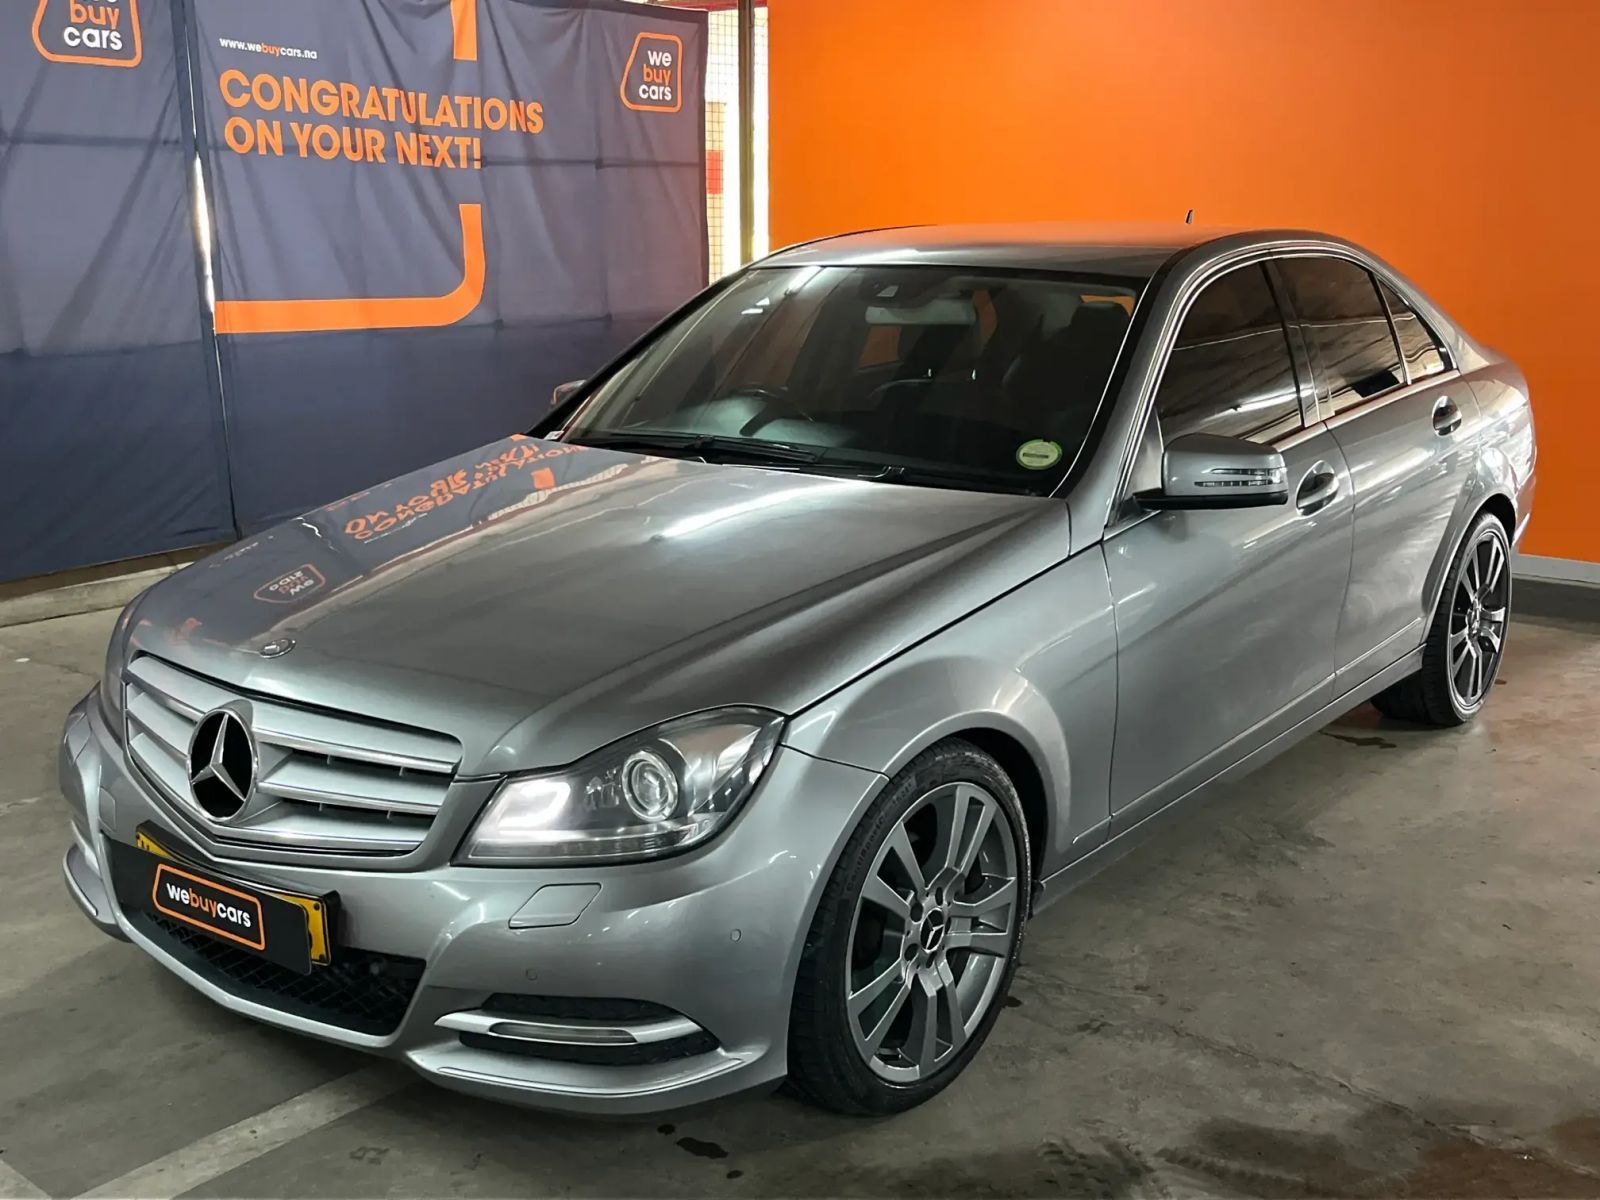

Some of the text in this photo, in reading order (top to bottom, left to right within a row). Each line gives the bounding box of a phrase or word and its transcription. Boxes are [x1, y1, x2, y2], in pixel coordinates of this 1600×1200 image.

[70, 0, 119, 29] buy
[64, 27, 122, 51] cars
[219, 38, 318, 59] www.webuycars.na
[647, 50, 672, 67] we
[643, 63, 671, 86] buy
[219, 68, 544, 134] CONGRATULATIONS
[638, 84, 672, 101] cars
[224, 116, 481, 169] ON YOUR NEXT!
[166, 882, 252, 928] webuycars
